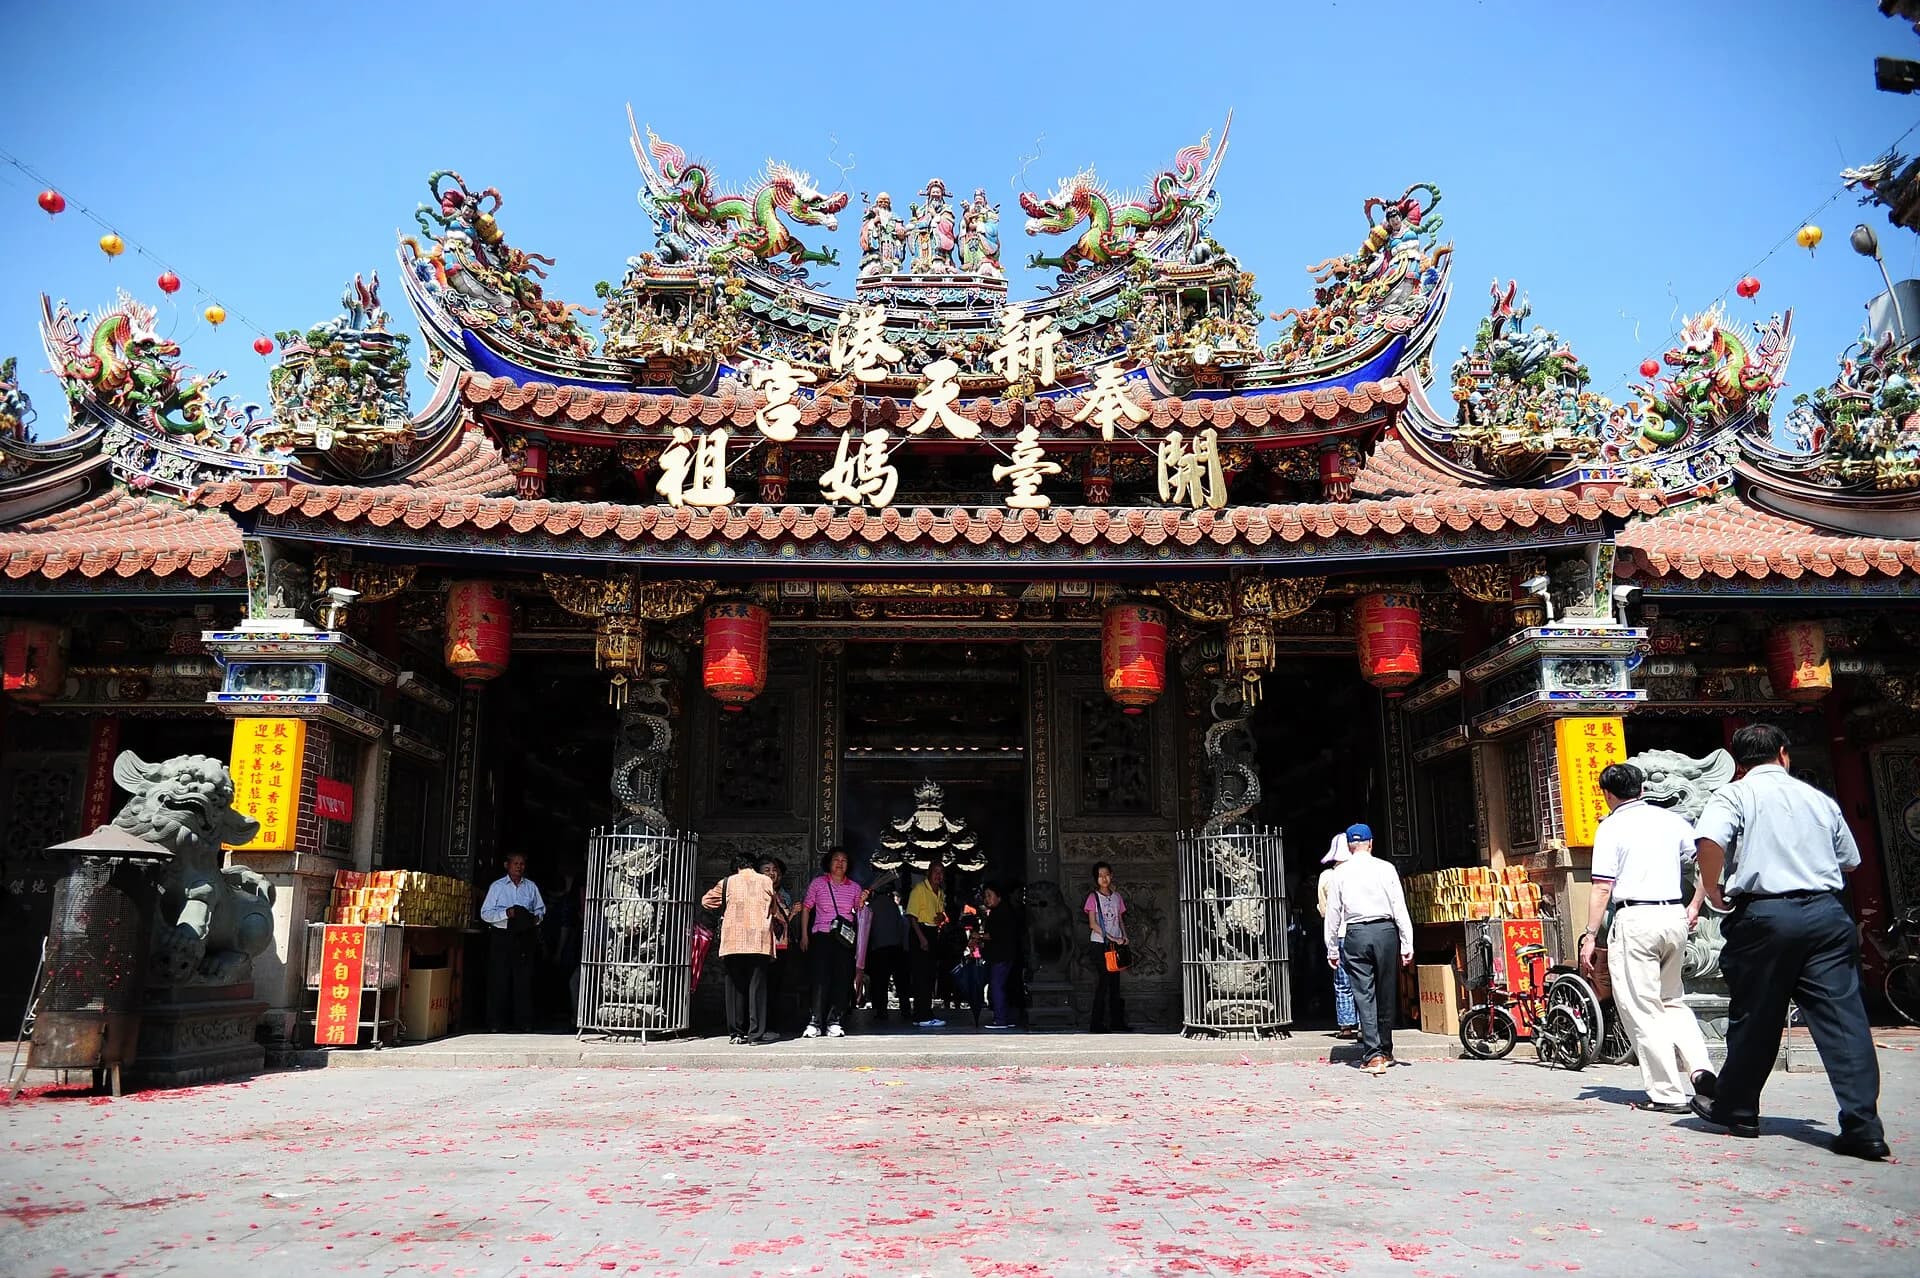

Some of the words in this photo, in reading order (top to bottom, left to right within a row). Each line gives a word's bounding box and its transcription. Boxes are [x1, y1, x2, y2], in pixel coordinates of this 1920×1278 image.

[327, 931, 363, 945] 奉天宮
[1507, 926, 1541, 939] 奉天宮
[332, 947, 358, 960] 金紙
[326, 962, 349, 1043] 自由樂捐
